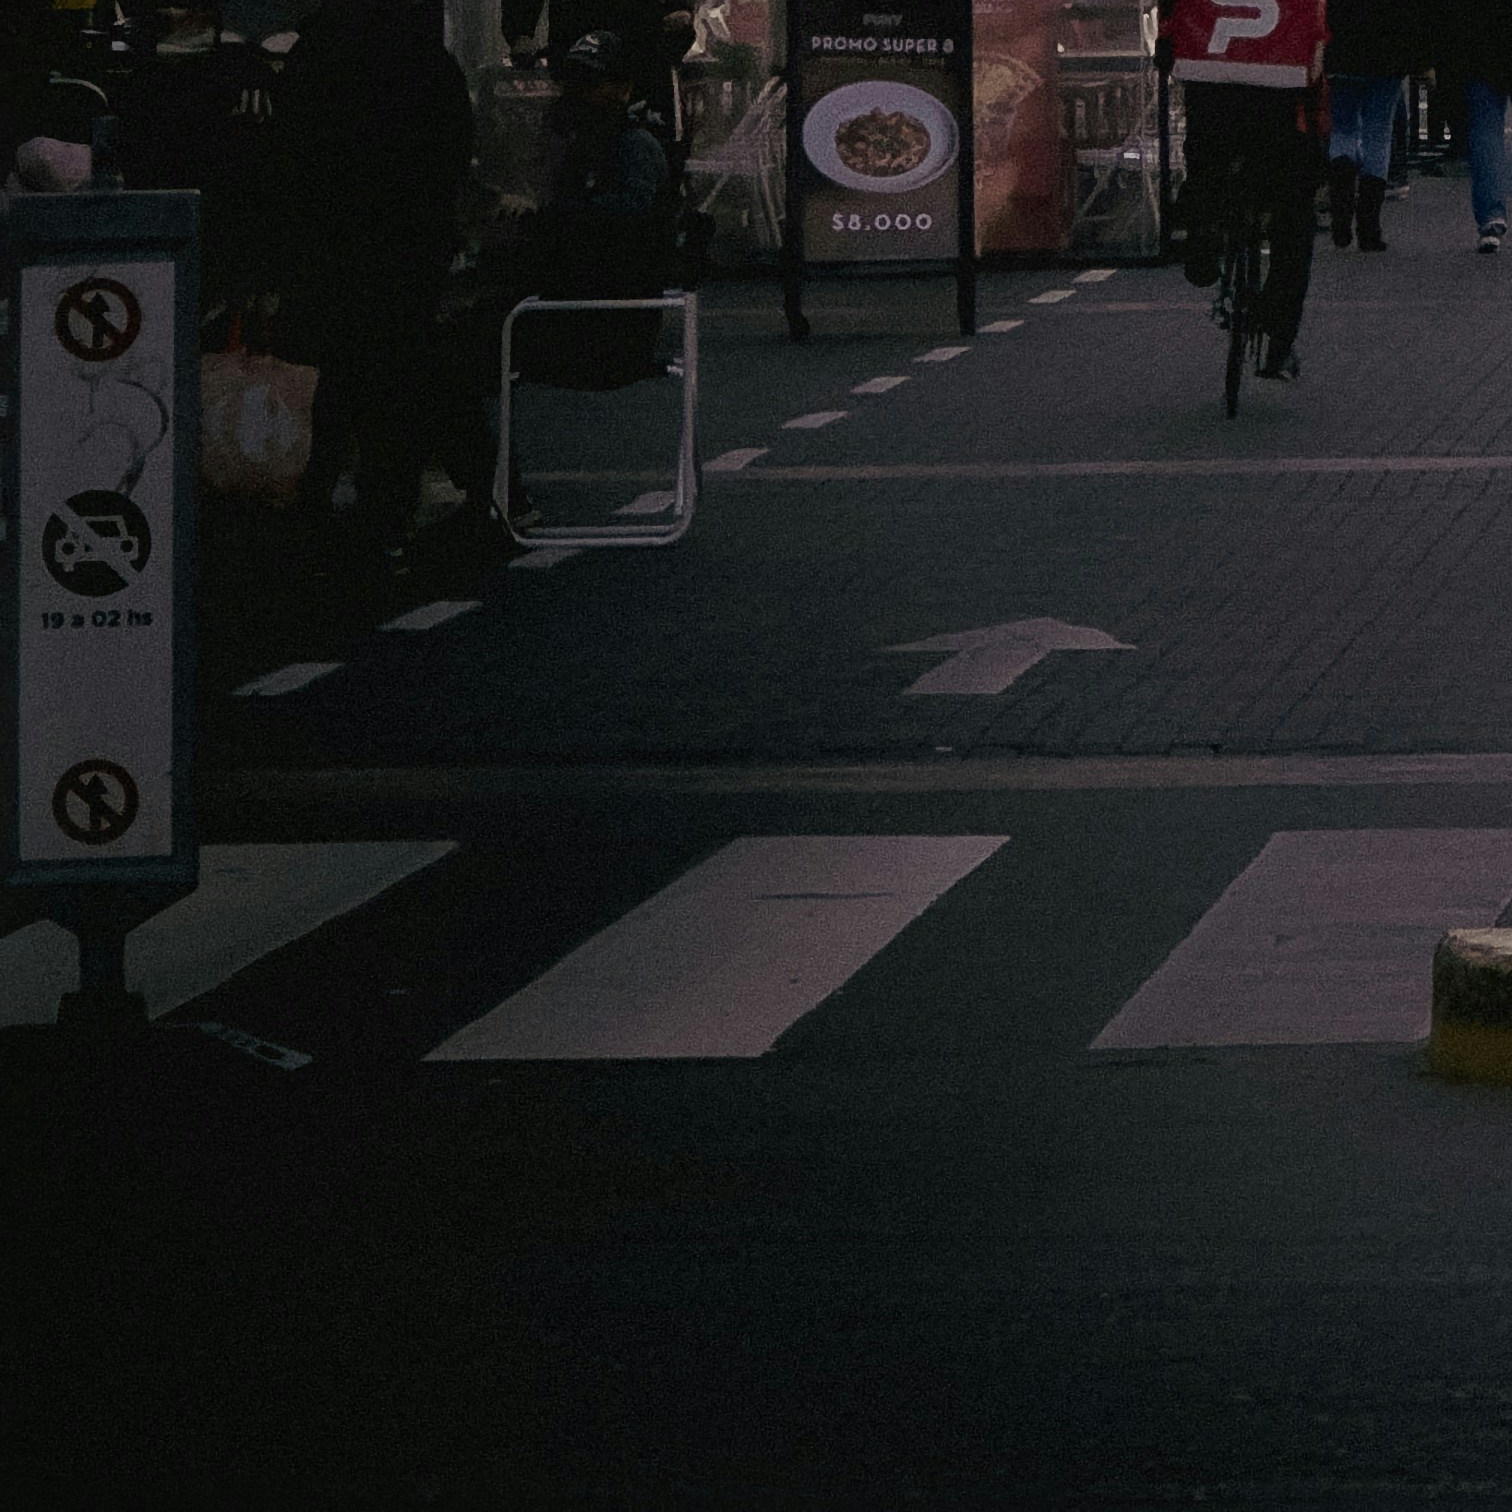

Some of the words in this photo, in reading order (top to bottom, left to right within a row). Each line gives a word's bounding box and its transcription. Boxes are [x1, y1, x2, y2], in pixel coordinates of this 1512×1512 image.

[811, 36, 878, 53] PROMO
[882, 37, 939, 54] SUPER
[41, 611, 65, 630] 19
[91, 609, 121, 628] 02
